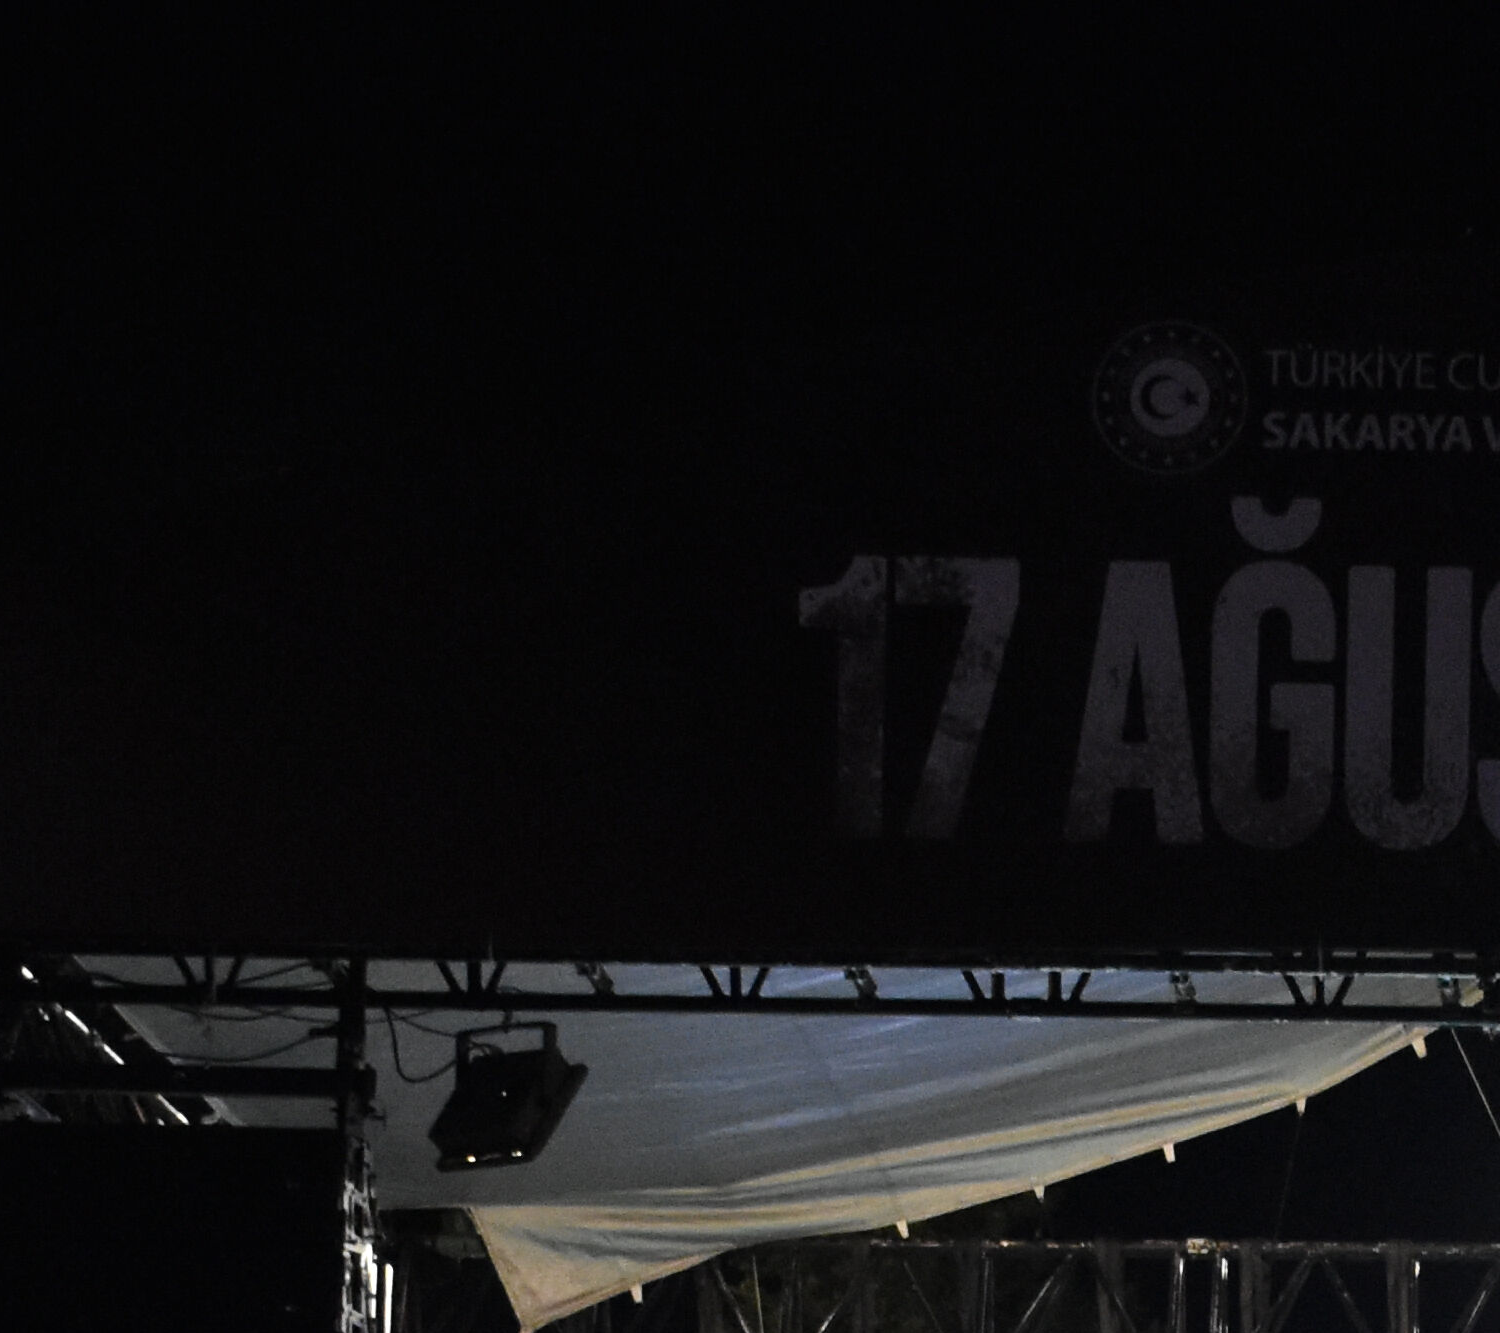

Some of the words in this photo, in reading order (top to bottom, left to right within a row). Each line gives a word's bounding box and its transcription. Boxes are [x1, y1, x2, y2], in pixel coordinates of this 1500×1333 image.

[1264, 344, 1437, 392] TÜRKİYE
[1262, 410, 1472, 452] SAKARYA
[797, 553, 1021, 842] 17
